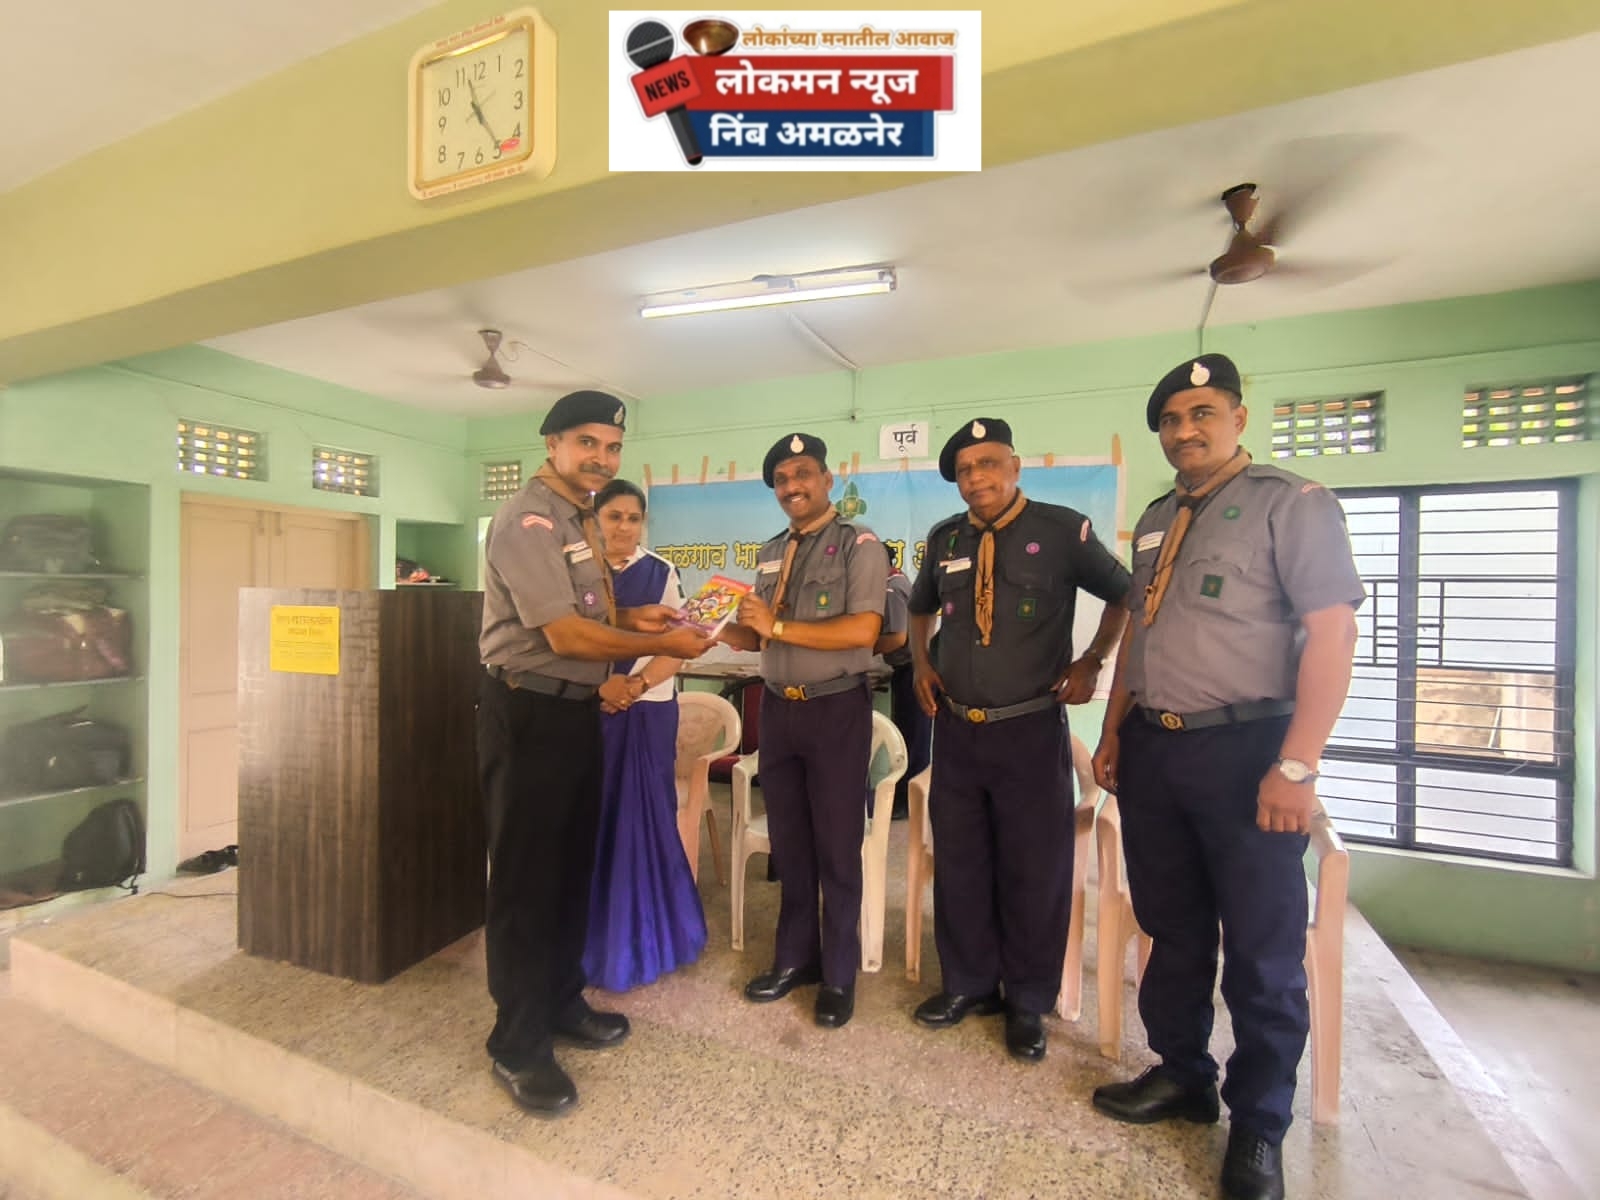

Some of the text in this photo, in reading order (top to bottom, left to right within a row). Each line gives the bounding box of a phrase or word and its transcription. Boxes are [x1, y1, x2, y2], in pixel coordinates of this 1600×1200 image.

[473, 61, 486, 81] 12
[497, 55, 501, 73] 1
[514, 59, 524, 78] 2
[456, 67, 466, 88] 11
[438, 88, 450, 106] 10
[514, 91, 523, 110] 3
[438, 117, 447, 134] 9
[438, 145, 446, 164] 8
[475, 147, 484, 165] 6
[492, 139, 502, 160] 5
[457, 152, 465, 171] 7
[892, 423, 919, 453] पूर्व
